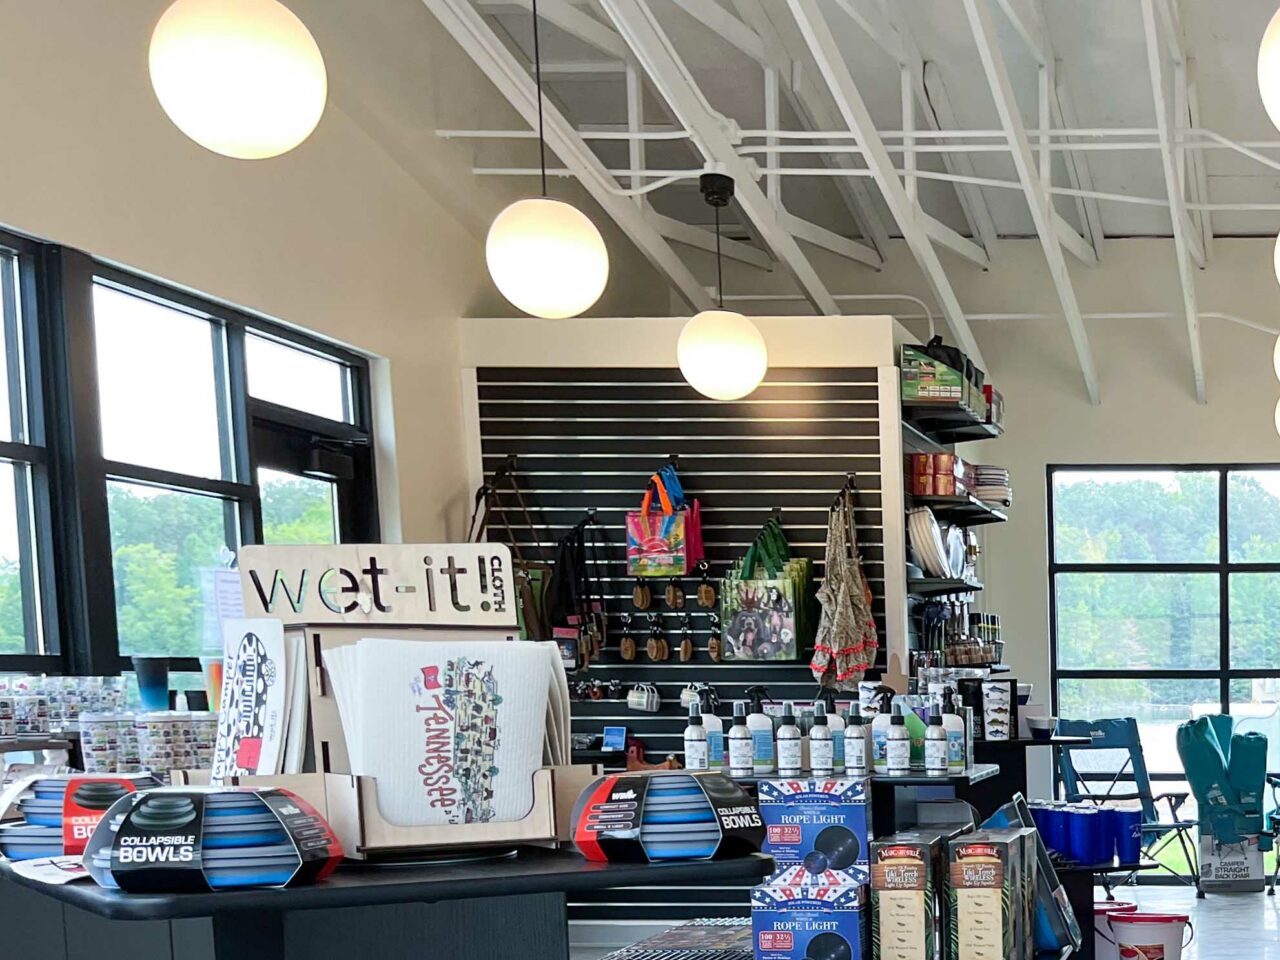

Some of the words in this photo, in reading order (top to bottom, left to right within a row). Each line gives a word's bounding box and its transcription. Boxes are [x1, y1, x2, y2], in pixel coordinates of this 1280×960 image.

[249, 555, 489, 614] wet-it!
[490, 554, 507, 613] CLOTH
[717, 806, 758, 816] COLLAPSIBLE
[721, 814, 762, 829] BOWLS
[781, 815, 811, 824] ROPE
[813, 814, 846, 824] LIGHT
[120, 835, 196, 845] COLLAPSIBLE
[119, 845, 194, 863] BOWLS
[773, 921, 803, 931] ROPE
[805, 921, 838, 931] LIGHT
